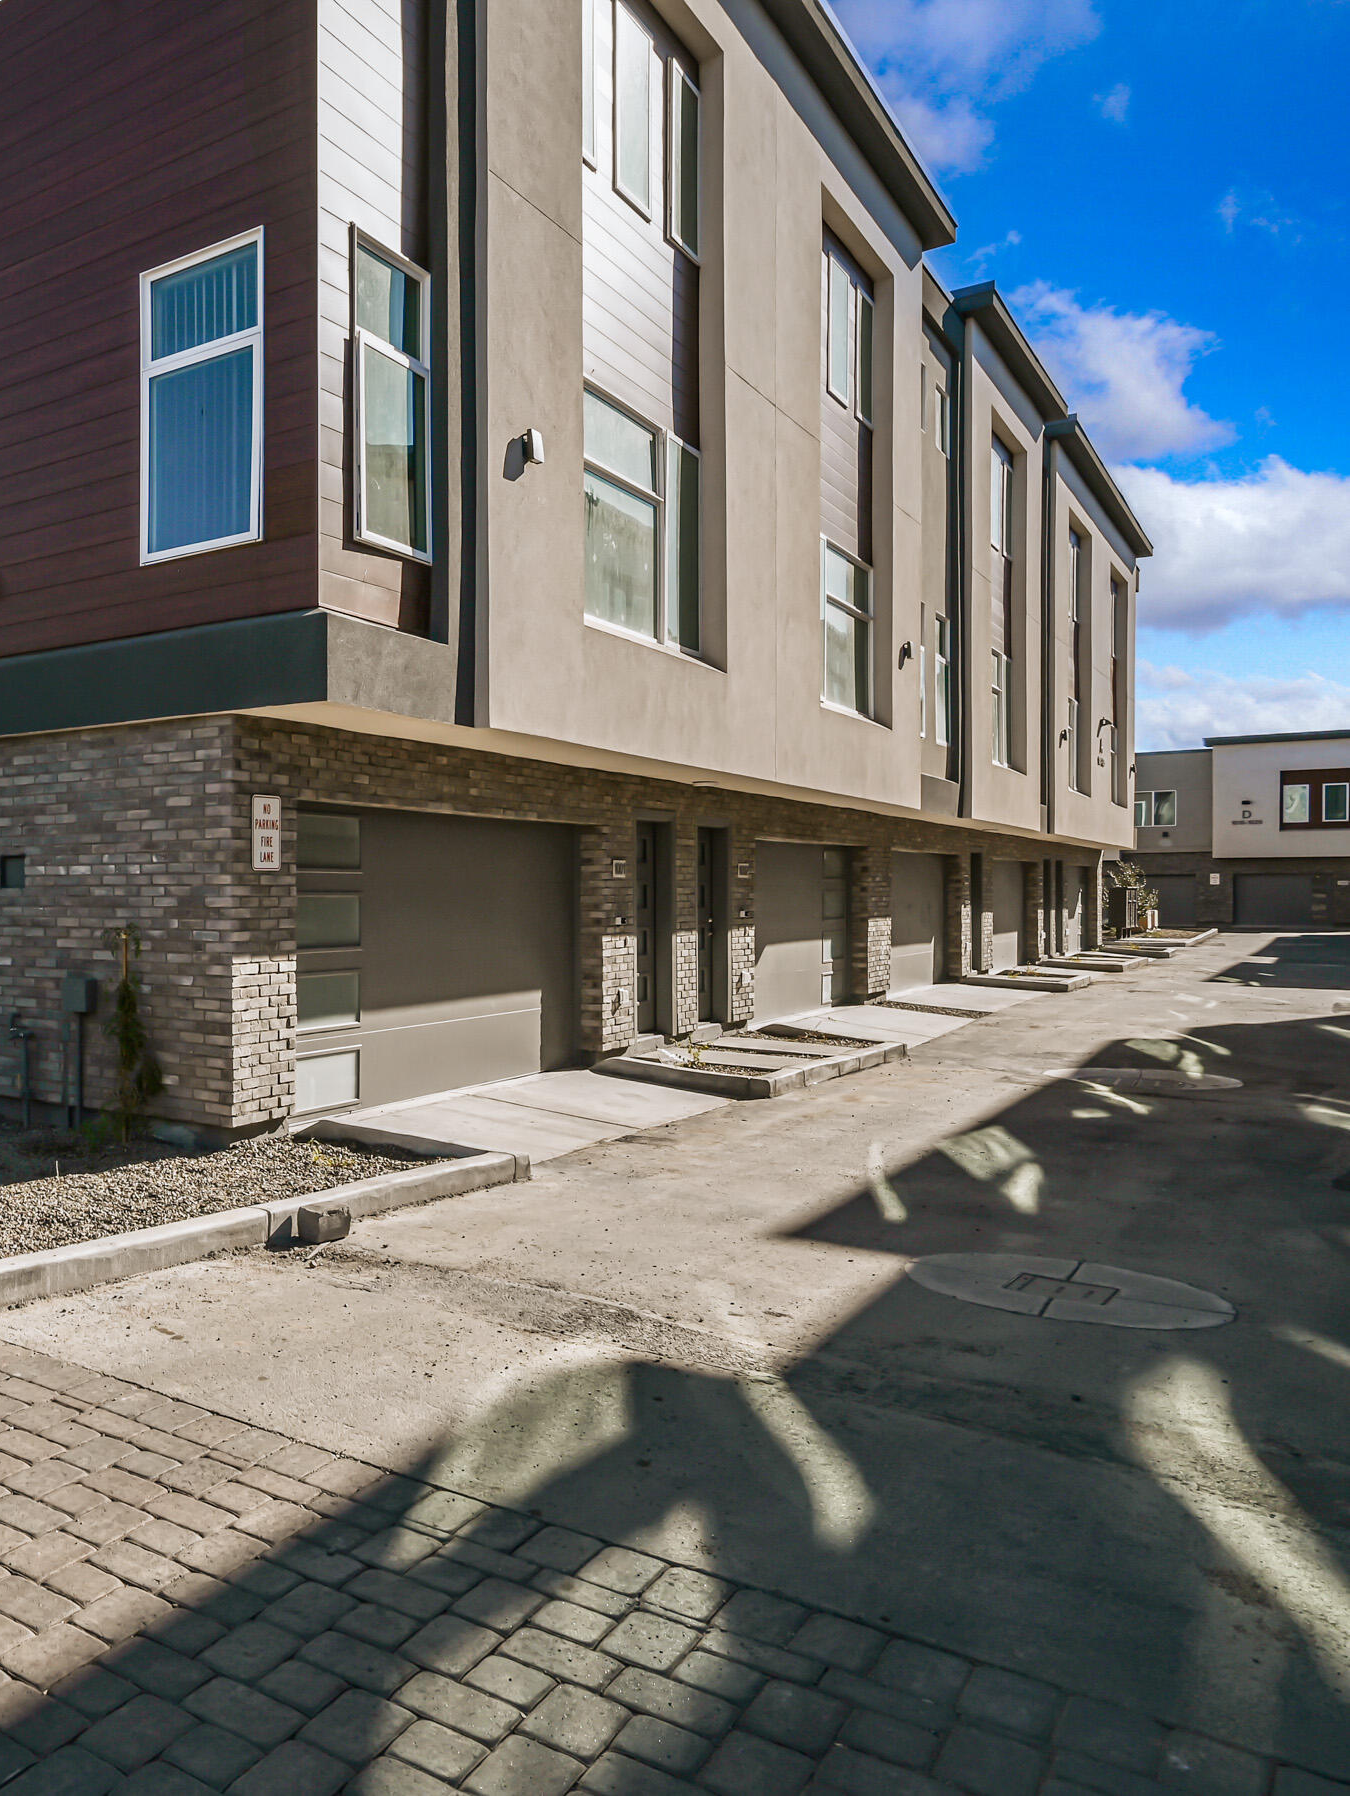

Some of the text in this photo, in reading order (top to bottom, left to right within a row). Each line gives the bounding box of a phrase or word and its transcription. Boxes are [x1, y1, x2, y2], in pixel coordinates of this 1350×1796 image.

[263, 804, 271, 814] NO
[255, 819, 279, 830] PARKING
[261, 836, 273, 847] FIRE
[260, 852, 274, 862] LANE
